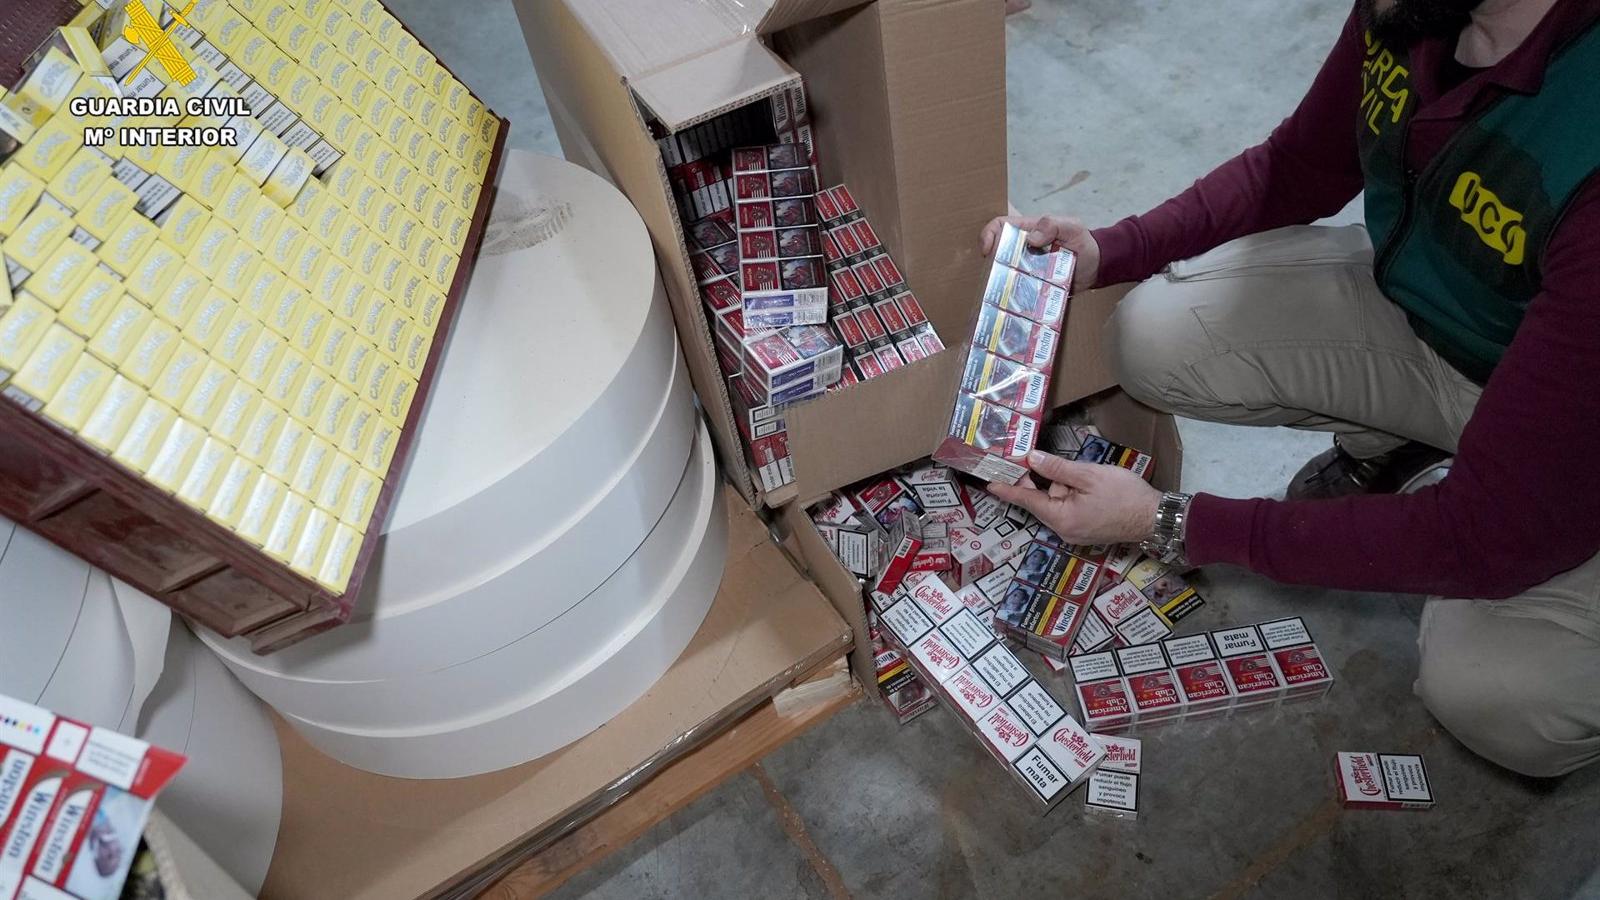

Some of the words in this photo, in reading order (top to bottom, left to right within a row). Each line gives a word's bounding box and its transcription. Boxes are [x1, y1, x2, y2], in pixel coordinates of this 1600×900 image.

[482, 119, 494, 144] CAMEL
[474, 150, 486, 176] CAMEL
[1036, 331, 1052, 361] Winston
[1026, 375, 1042, 406] Winston
[1133, 455, 1149, 475] inston
[1076, 563, 1094, 592] Winston
[914, 586, 952, 616] Chesterfield
[1107, 590, 1148, 620] Chesterfield
[1020, 610, 1032, 629] Fumar
[1056, 604, 1076, 634] Winston
[1223, 632, 1250, 641] mata
[1224, 638, 1256, 650] Fumar
[921, 638, 961, 670] Chesterfield
[1254, 670, 1274, 681] Club
[1285, 670, 1326, 684] American
[1302, 662, 1324, 672] Club
[952, 673, 994, 708] Chesterfield
[1154, 688, 1176, 698] Club
[1189, 684, 1226, 699] American
[1203, 679, 1225, 689] Club
[1237, 678, 1277, 692] American
[1089, 704, 1128, 716] American
[1106, 697, 1127, 706] Club
[1138, 694, 1178, 708] American
[988, 710, 1030, 748] Chesterfield
[1053, 728, 1096, 764] Chesterfield
[1104, 747, 1136, 763] sterfield
[1025, 766, 1048, 789] mata
[1030, 754, 1060, 784] Fumar
[1350, 755, 1382, 796] Chesterfield
[7, 789, 53, 862] Winston
[40, 802, 84, 875] Winston
